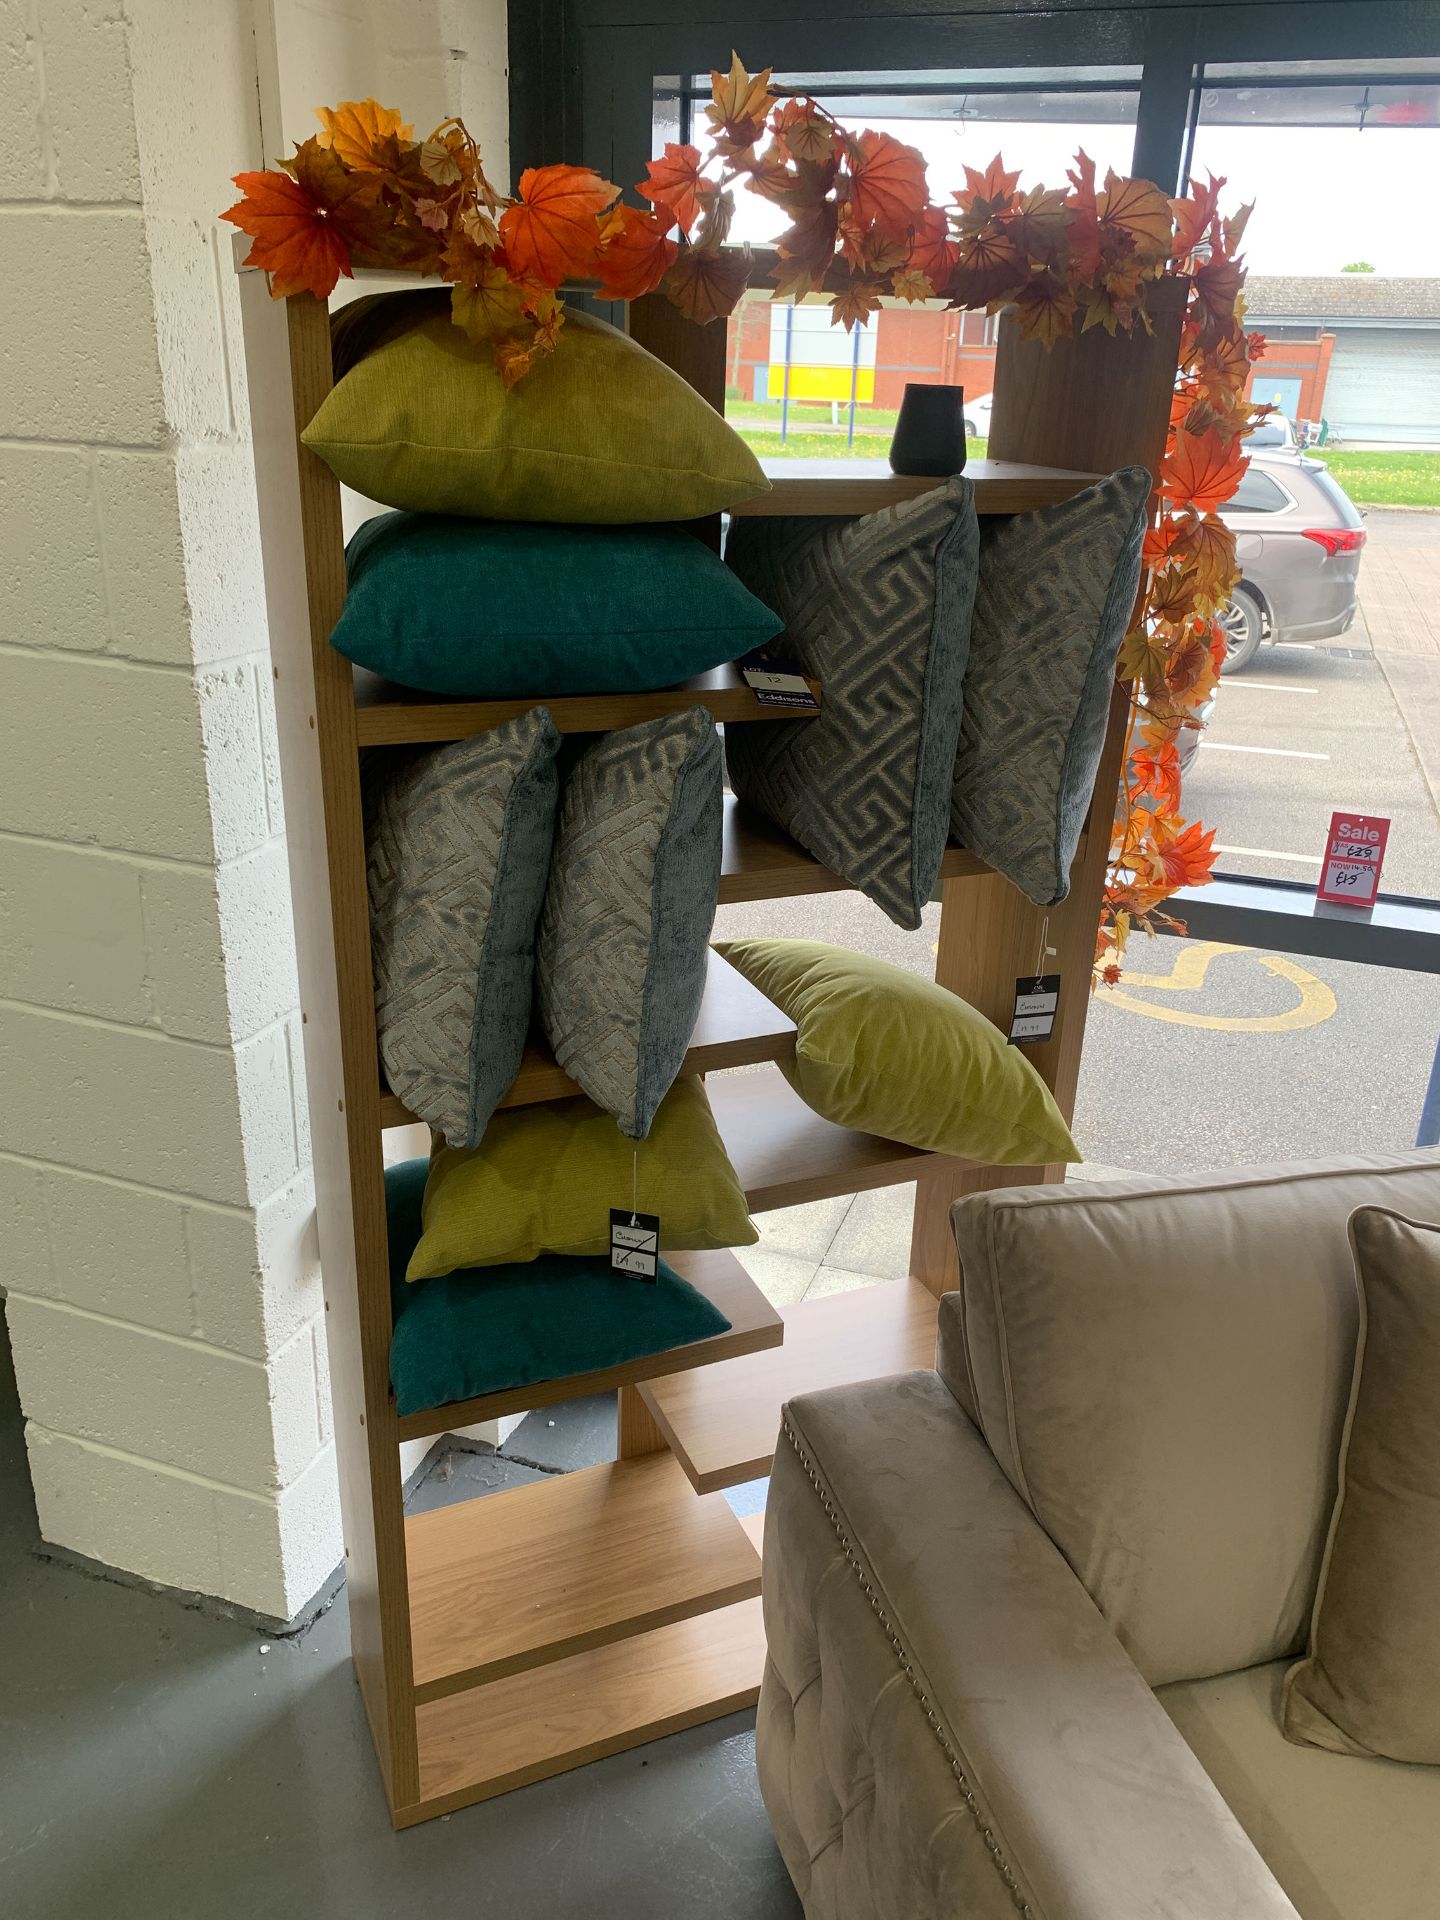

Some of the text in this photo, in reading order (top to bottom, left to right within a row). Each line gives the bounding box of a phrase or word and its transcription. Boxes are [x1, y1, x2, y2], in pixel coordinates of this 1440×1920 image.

[766, 676, 782, 684] 12
[757, 692, 815, 704] Eddisons
[1338, 823, 1380, 841] Sale
[1330, 862, 1351, 870] NOW
